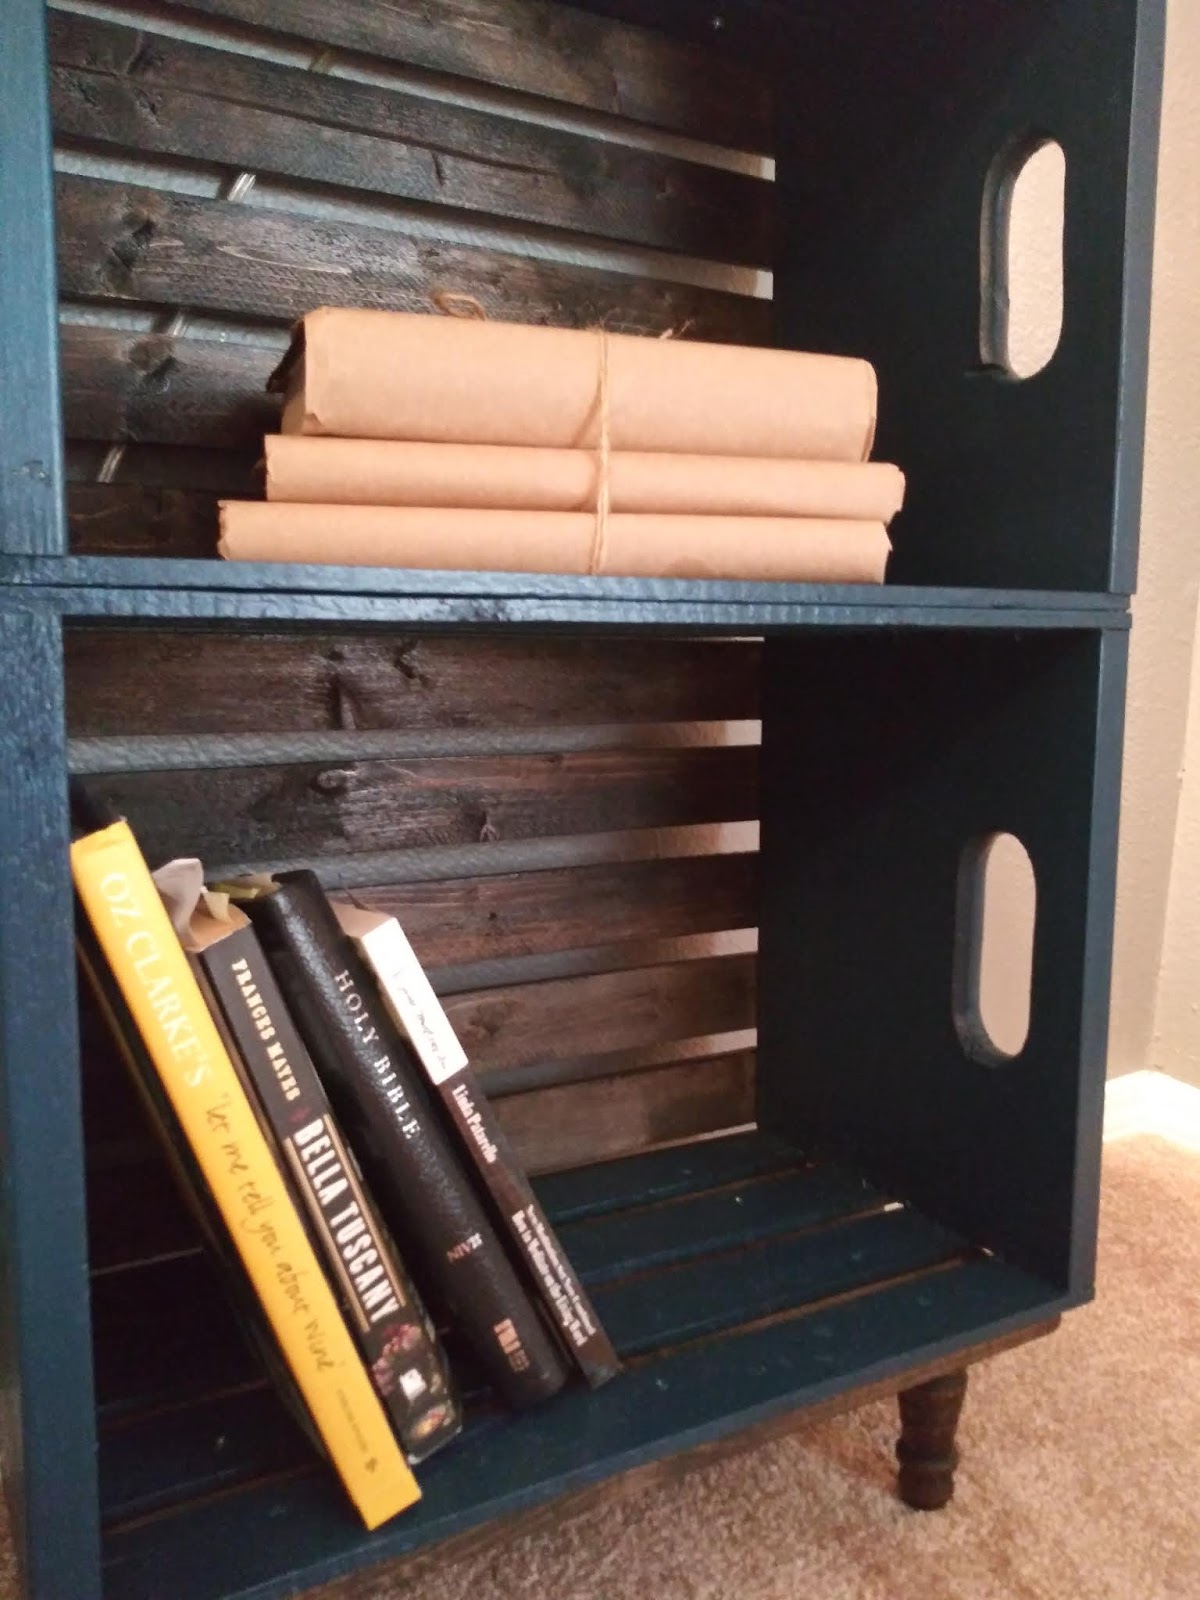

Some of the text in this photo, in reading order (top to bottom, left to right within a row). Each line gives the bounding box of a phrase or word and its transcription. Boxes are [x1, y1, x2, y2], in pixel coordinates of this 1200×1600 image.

[100, 872, 214, 1089] OZ CLARKE'S
[231, 957, 301, 1101] FRANCES MAYES
[334, 969, 380, 1043] HOLY
[373, 1055, 421, 1140] BIBLE
[223, 1143, 248, 1175] me
[239, 1213, 282, 1258] you
[276, 1259, 310, 1315] about
[293, 1118, 349, 1207] BELLA
[330, 1200, 400, 1324] TUSCANY
